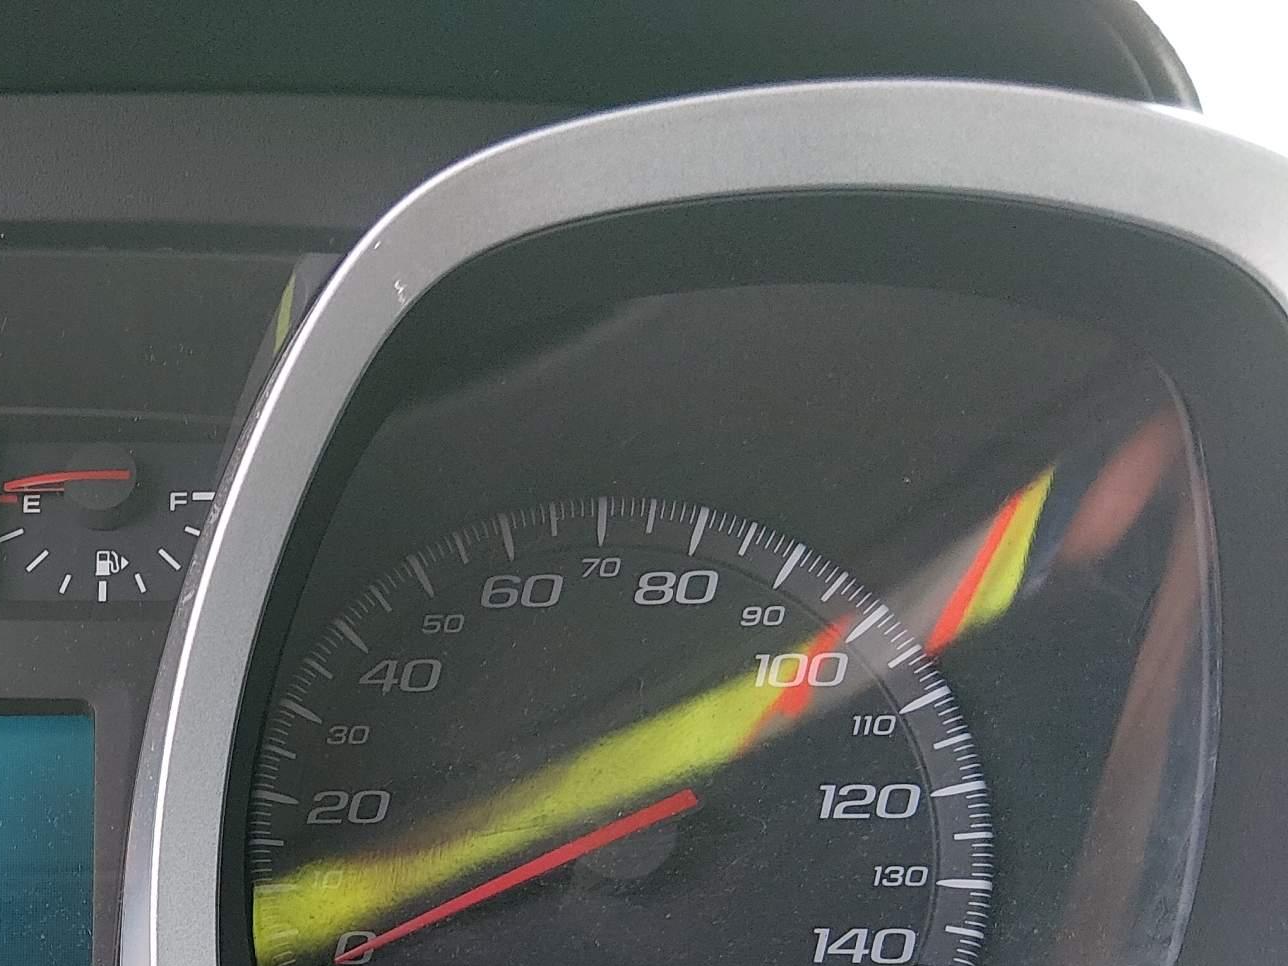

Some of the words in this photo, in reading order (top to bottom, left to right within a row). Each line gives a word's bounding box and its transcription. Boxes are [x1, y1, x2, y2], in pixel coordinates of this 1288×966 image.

[23, 495, 41, 514] E
[170, 493, 188, 511] F
[581, 558, 622, 578] 70
[481, 574, 564, 609] 60
[634, 571, 718, 606] 80
[421, 614, 465, 634] 50
[740, 606, 785, 627] 90
[359, 658, 442, 693] 40
[754, 653, 849, 687] 100
[326, 725, 370, 745] 30
[852, 716, 896, 736] 110
[306, 790, 391, 825] 20
[818, 785, 921, 820] 120
[872, 867, 929, 887] 130
[334, 931, 377, 965] 0
[813, 928, 915, 963] 140
